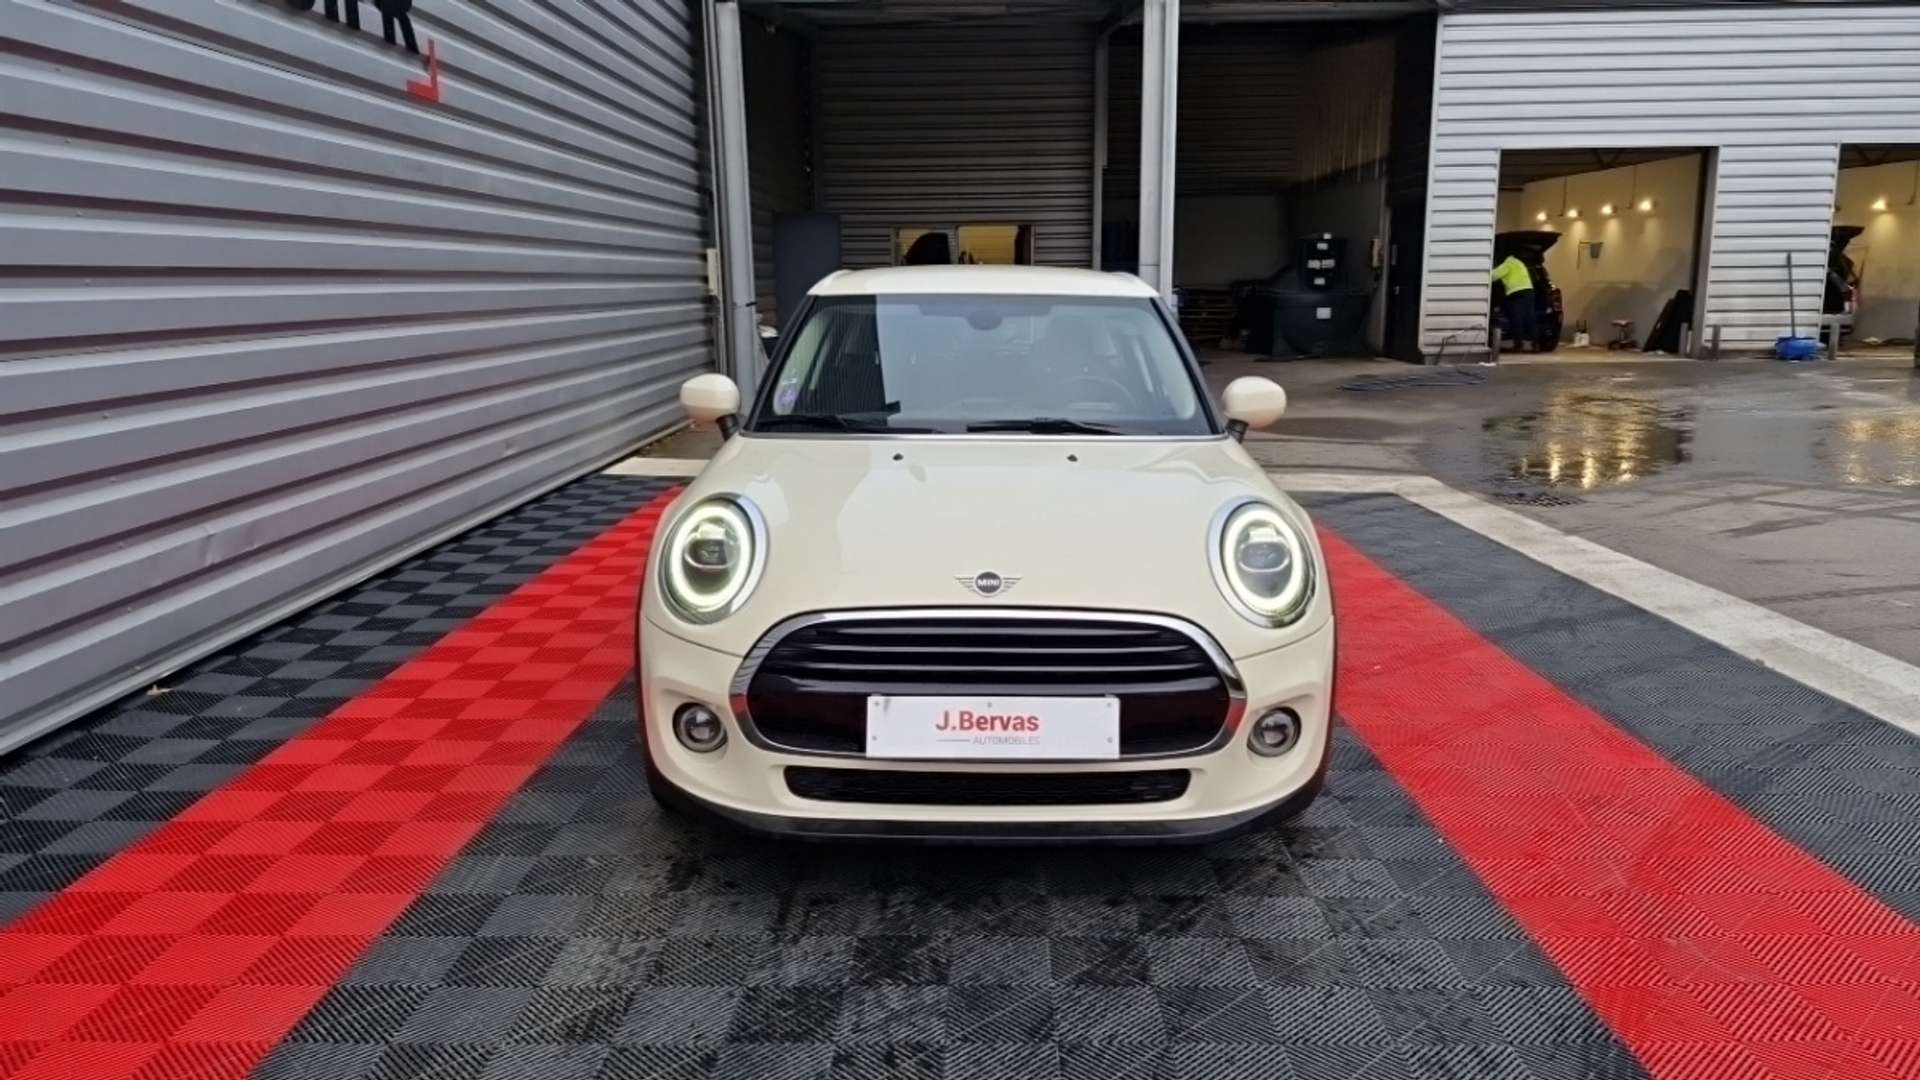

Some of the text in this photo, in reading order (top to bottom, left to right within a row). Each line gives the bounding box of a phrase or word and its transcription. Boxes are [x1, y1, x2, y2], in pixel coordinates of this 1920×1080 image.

[977, 578, 1000, 587] MINI
[936, 710, 1039, 731] J.Bervas
[972, 735, 1040, 745] AUTOMOBILES
